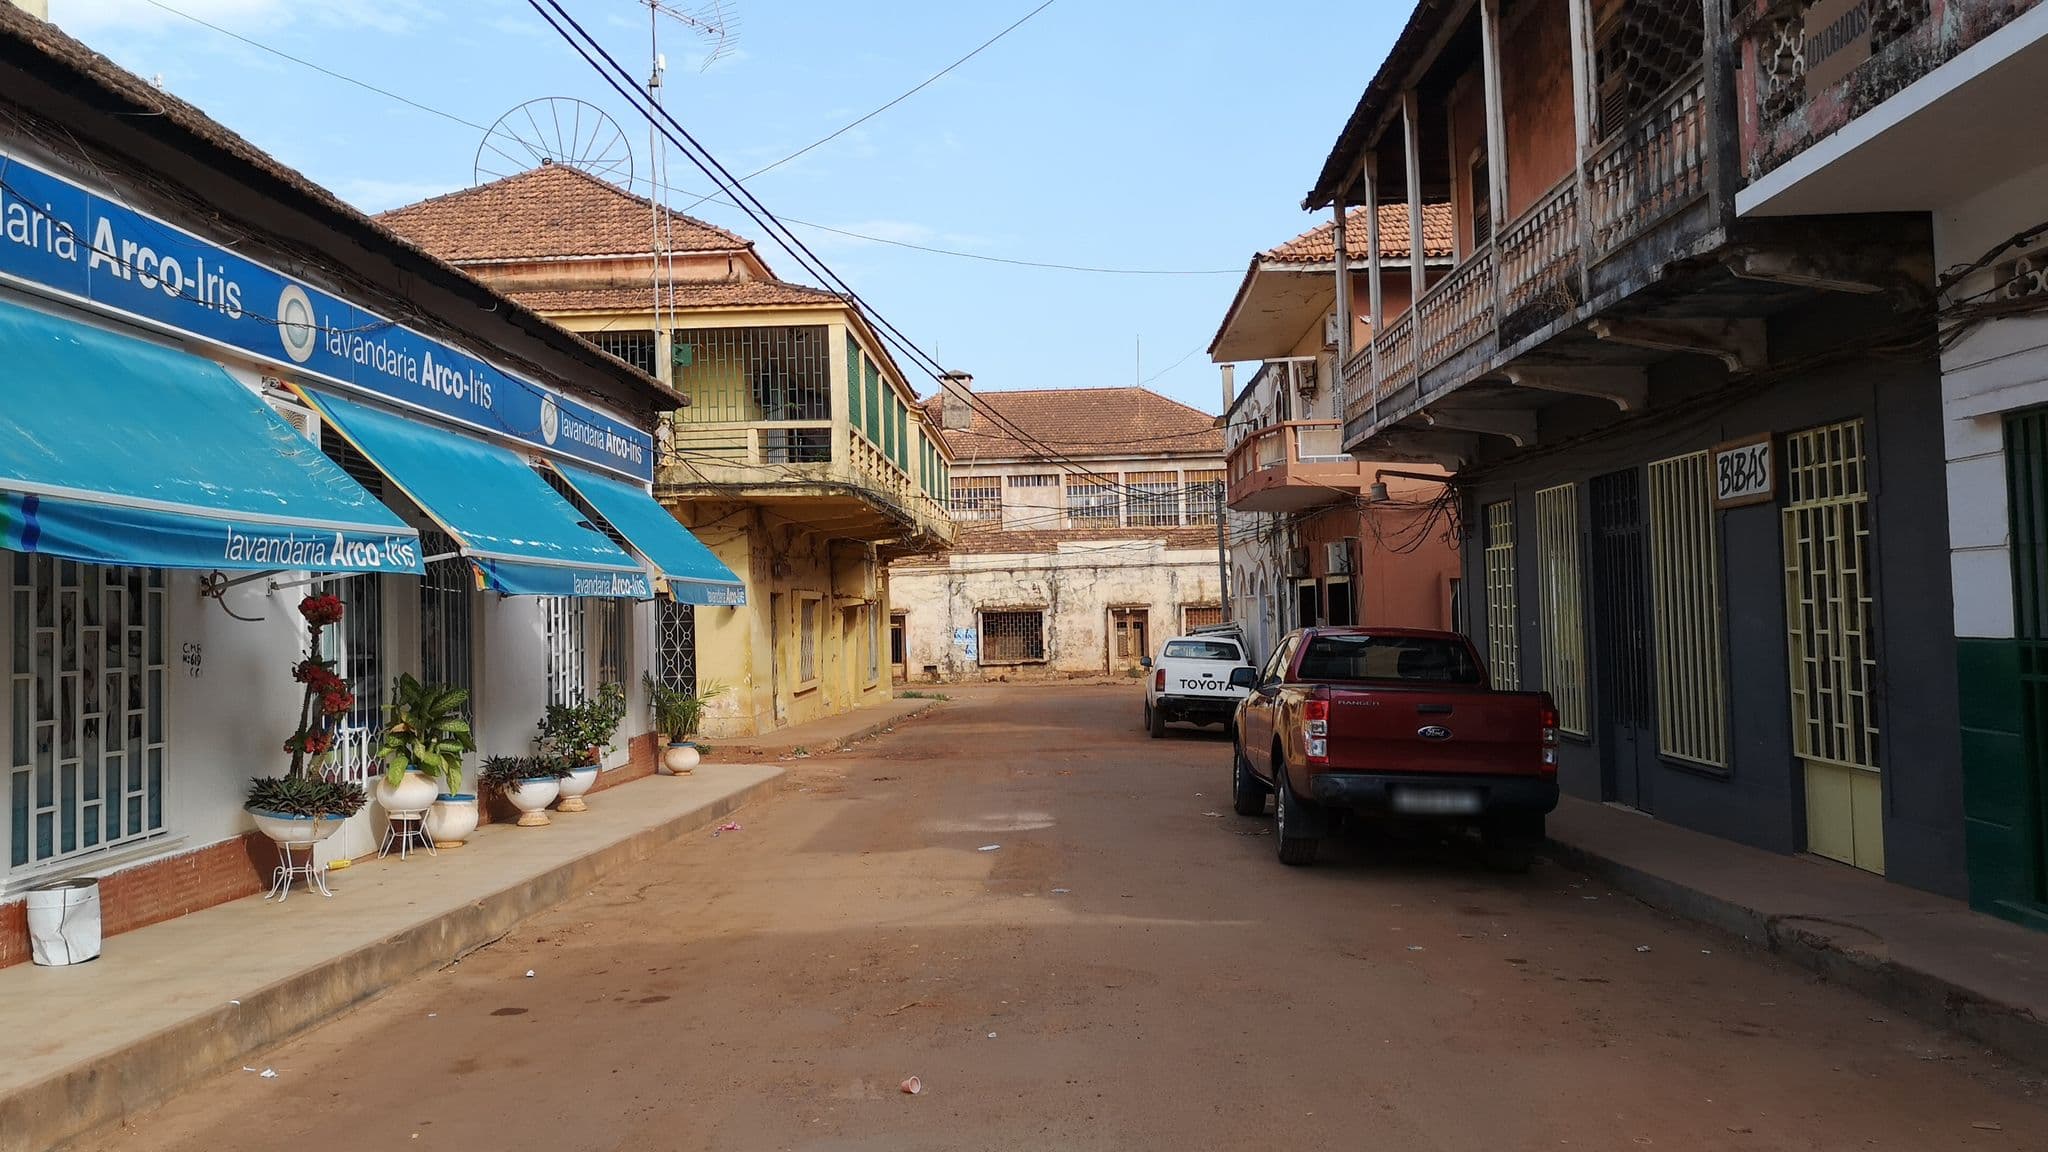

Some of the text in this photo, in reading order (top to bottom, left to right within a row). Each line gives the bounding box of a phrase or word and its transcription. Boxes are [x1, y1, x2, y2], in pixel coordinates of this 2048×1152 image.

[90, 216, 242, 319] Arco-Iris
[325, 315, 492, 409] lavandaria Arco-Iris
[561, 411, 642, 464] lavandaria Arco-Iris
[1719, 446, 1768, 497] BIBAS
[225, 525, 416, 568] lavandaria Arco-Iris
[573, 572, 647, 595] lavandaria Arco-Iris
[1179, 679, 1235, 692] TOYOTA
